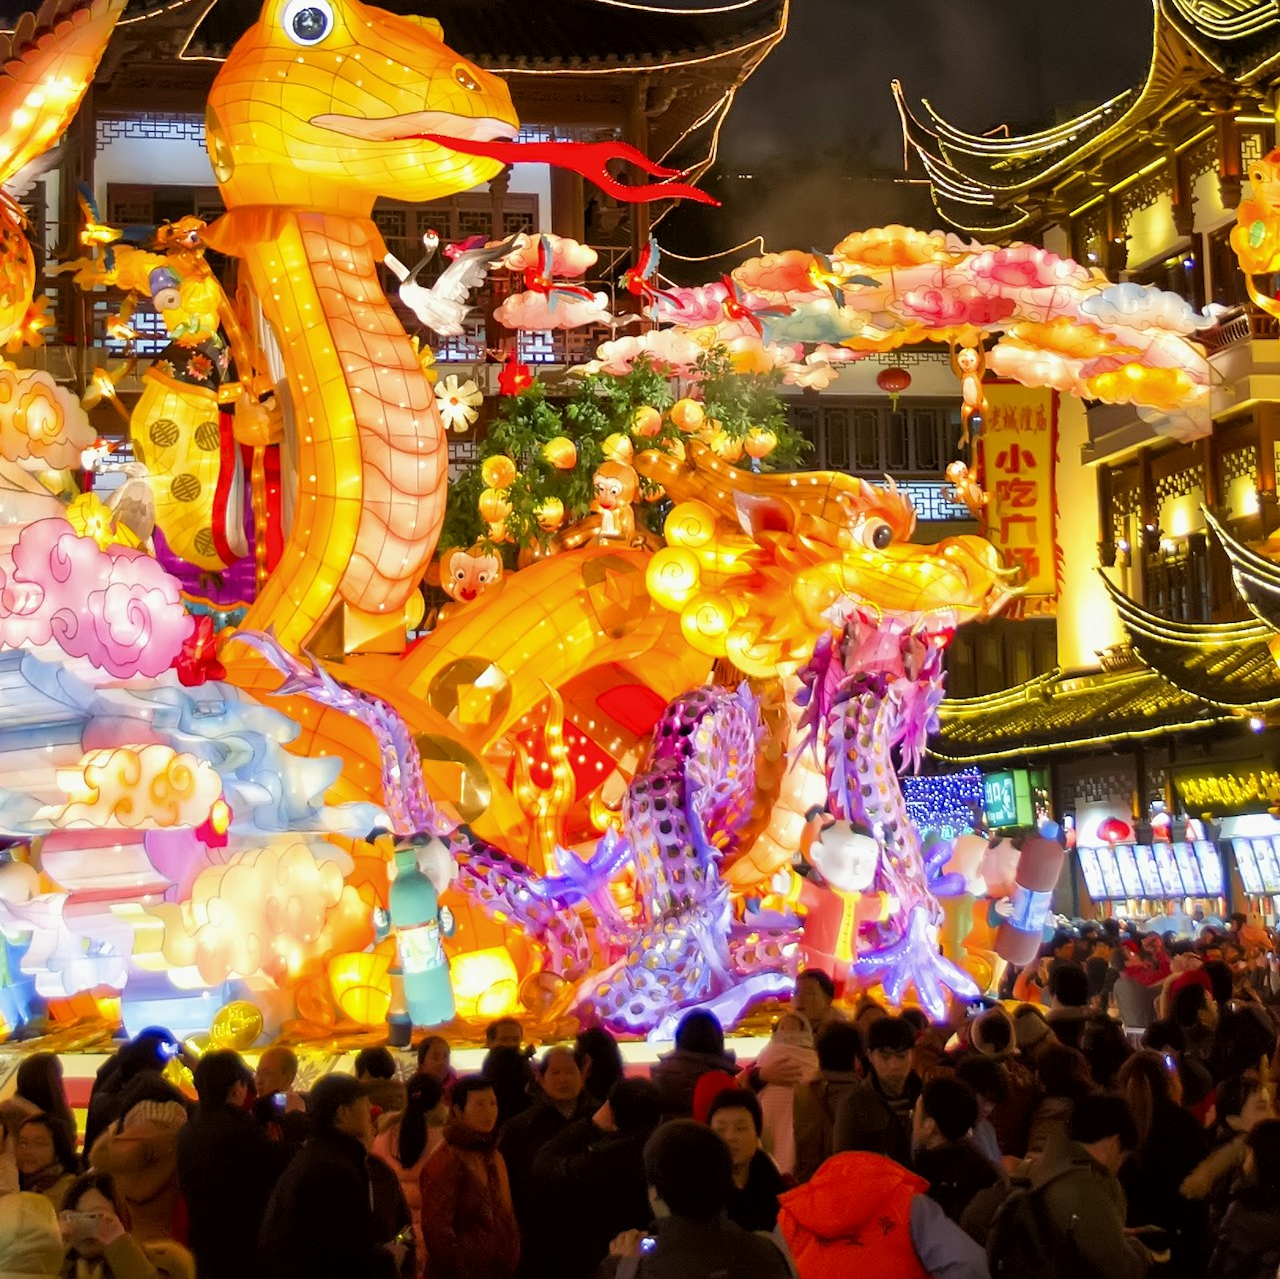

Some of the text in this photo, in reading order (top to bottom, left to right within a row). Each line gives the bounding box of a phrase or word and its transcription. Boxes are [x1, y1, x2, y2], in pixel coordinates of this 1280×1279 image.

[994, 442, 1041, 579] 小吃广场
[985, 782, 1001, 803] 出口
